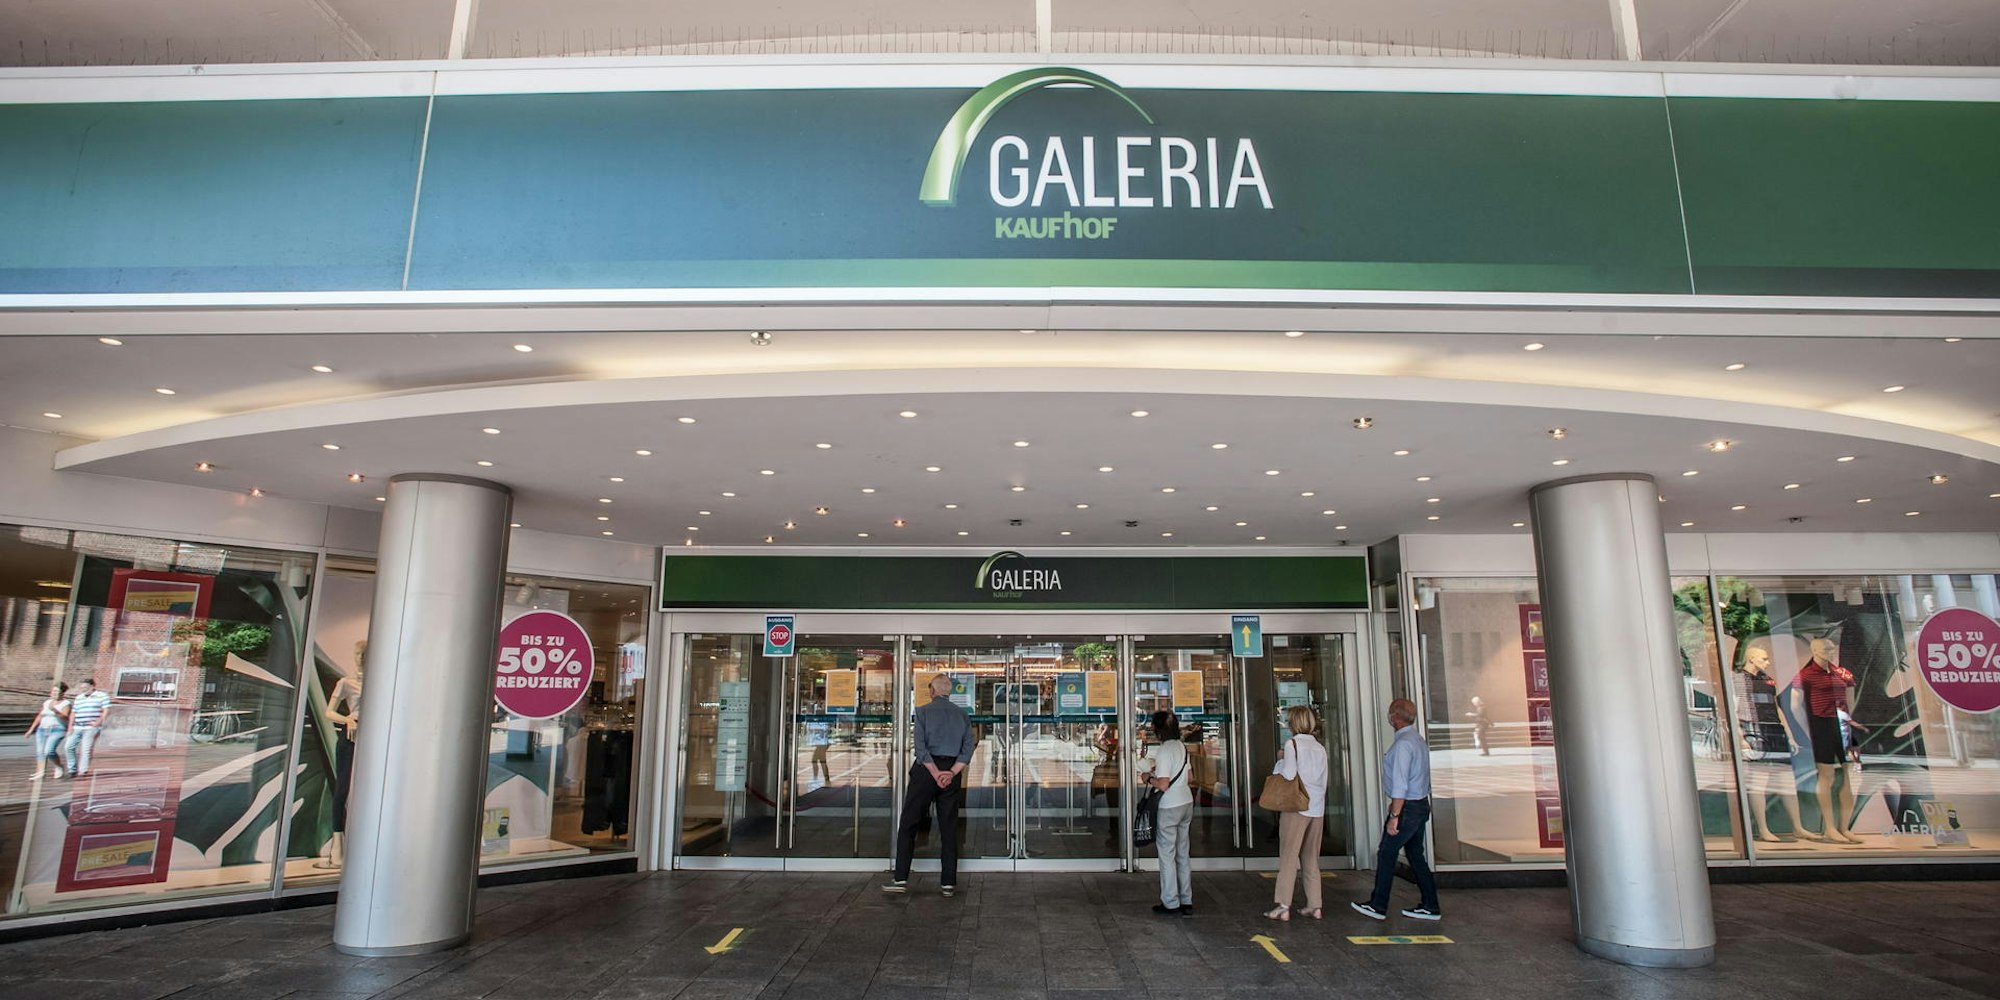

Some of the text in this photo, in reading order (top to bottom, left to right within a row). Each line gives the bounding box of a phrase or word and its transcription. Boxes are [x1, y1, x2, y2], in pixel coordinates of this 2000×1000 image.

[989, 134, 1273, 209] GALERIA
[991, 569, 1062, 590] GALERIA
[521, 634, 565, 646] BIS ZU
[771, 631, 789, 640] STOP
[1941, 631, 1984, 642] BIS ZU
[496, 647, 583, 675] 50%
[1927, 643, 2000, 669] 50%
[496, 676, 582, 689] REDUZIERT
[1929, 671, 2000, 683] REDUZIER
